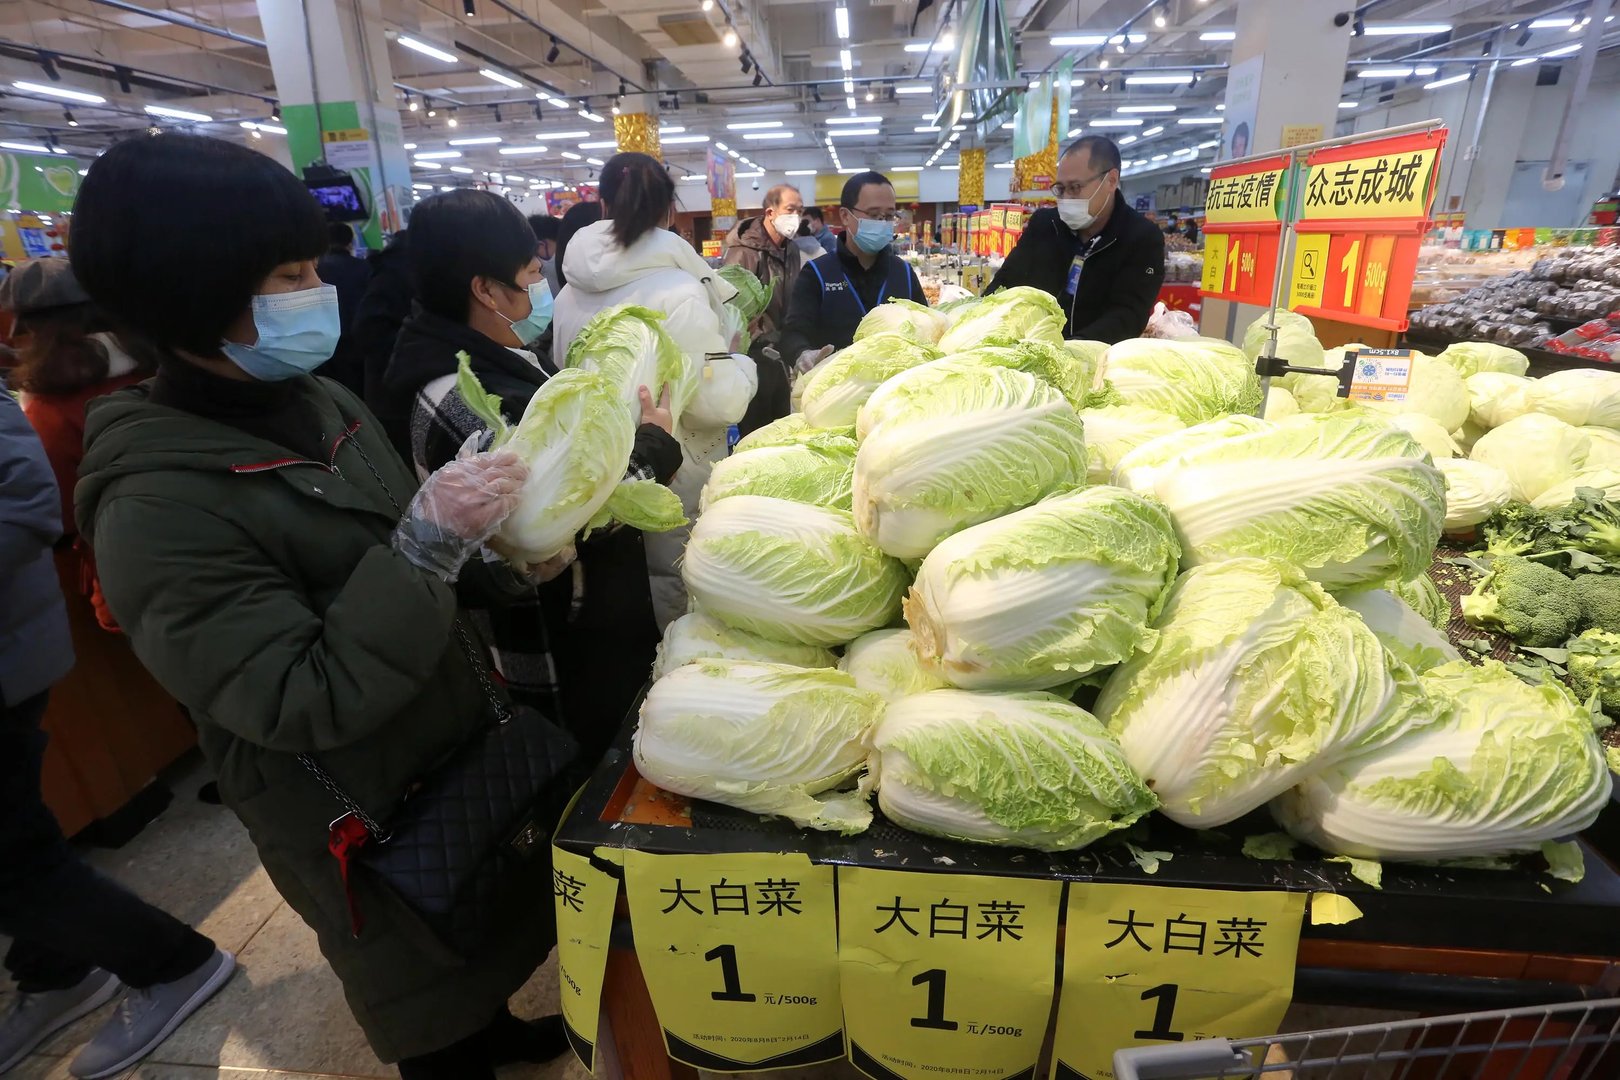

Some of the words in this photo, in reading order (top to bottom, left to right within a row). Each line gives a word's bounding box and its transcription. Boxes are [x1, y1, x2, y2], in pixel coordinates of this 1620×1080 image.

[1207, 172, 1277, 210] 抗击疫情
[1306, 154, 1423, 207] 众志成城
[1218, 240, 1240, 292] 1
[1240, 252, 1255, 278] 500g
[1341, 240, 1360, 308] 1
[1364, 261, 1387, 296] 500g
[552, 867, 587, 913] 菜
[660, 877, 803, 917] 大白菜
[874, 896, 1026, 942] 大白菜
[1104, 909, 1267, 958] 大白菜
[704, 944, 756, 1002] 1
[764, 992, 818, 1006] 元/500g
[910, 968, 958, 1031] 1
[1133, 983, 1184, 1042] 1
[966, 1021, 1023, 1038] 元/500g
